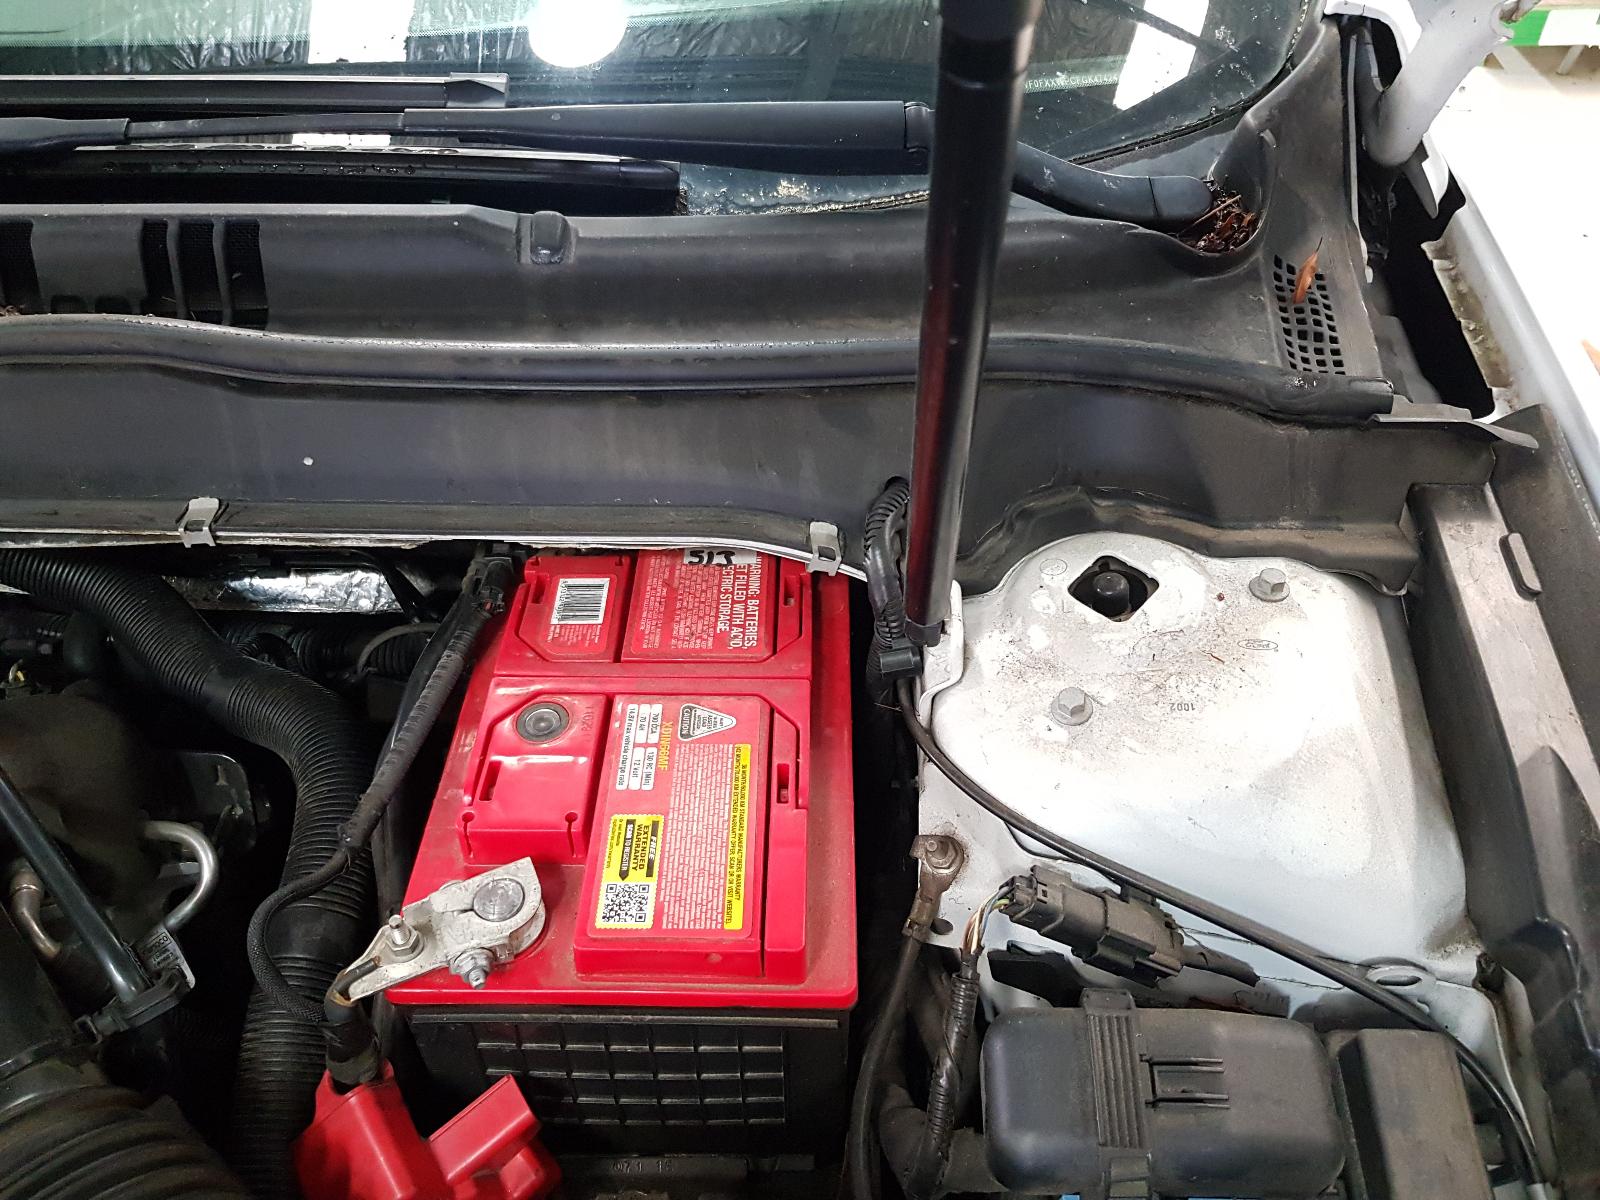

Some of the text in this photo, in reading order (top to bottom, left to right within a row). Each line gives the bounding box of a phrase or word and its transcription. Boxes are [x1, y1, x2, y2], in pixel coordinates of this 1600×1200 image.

[733, 575, 748, 600] FILLED
[717, 594, 732, 633] STORAGE.
[731, 603, 746, 624] WITH
[742, 599, 760, 649] BATTERIES,
[727, 626, 744, 649] ACID,
[682, 708, 691, 735] CAUTION
[623, 735, 631, 753] vehicle
[646, 752, 655, 761] 130
[658, 721, 674, 771] XDIN66MF
[619, 755, 628, 773] charge
[620, 824, 634, 870] SCAN TO REGISTER
[632, 824, 643, 872] WARRANTY
[639, 825, 650, 870] EXTENDED
[648, 836, 657, 860] FREE
